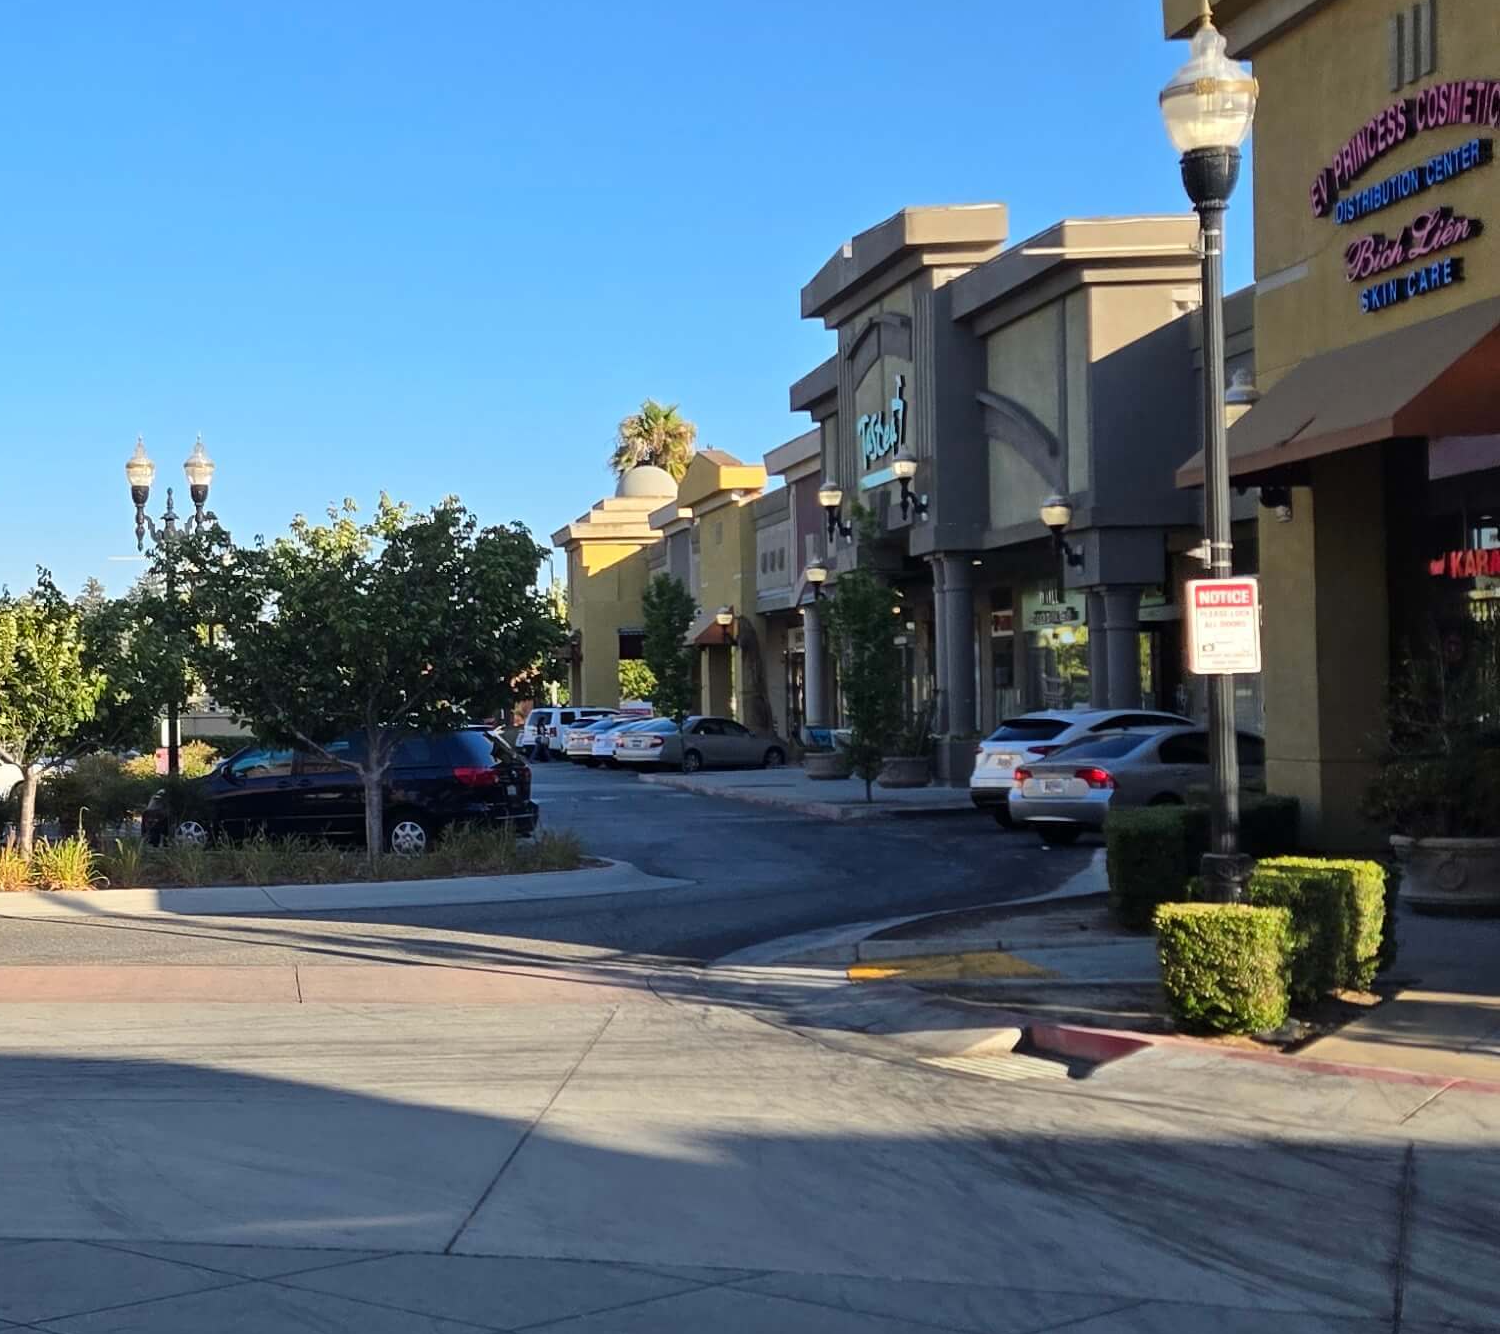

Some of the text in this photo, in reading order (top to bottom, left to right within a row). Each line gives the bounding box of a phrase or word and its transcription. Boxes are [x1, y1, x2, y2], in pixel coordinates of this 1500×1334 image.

[1331, 98, 1407, 189] PRINCESS
[1334, 138, 1481, 225] DISTRIBUTION CENTER
[1358, 257, 1453, 313] SKIN CARE
[1199, 590, 1250, 605] NOTICE
